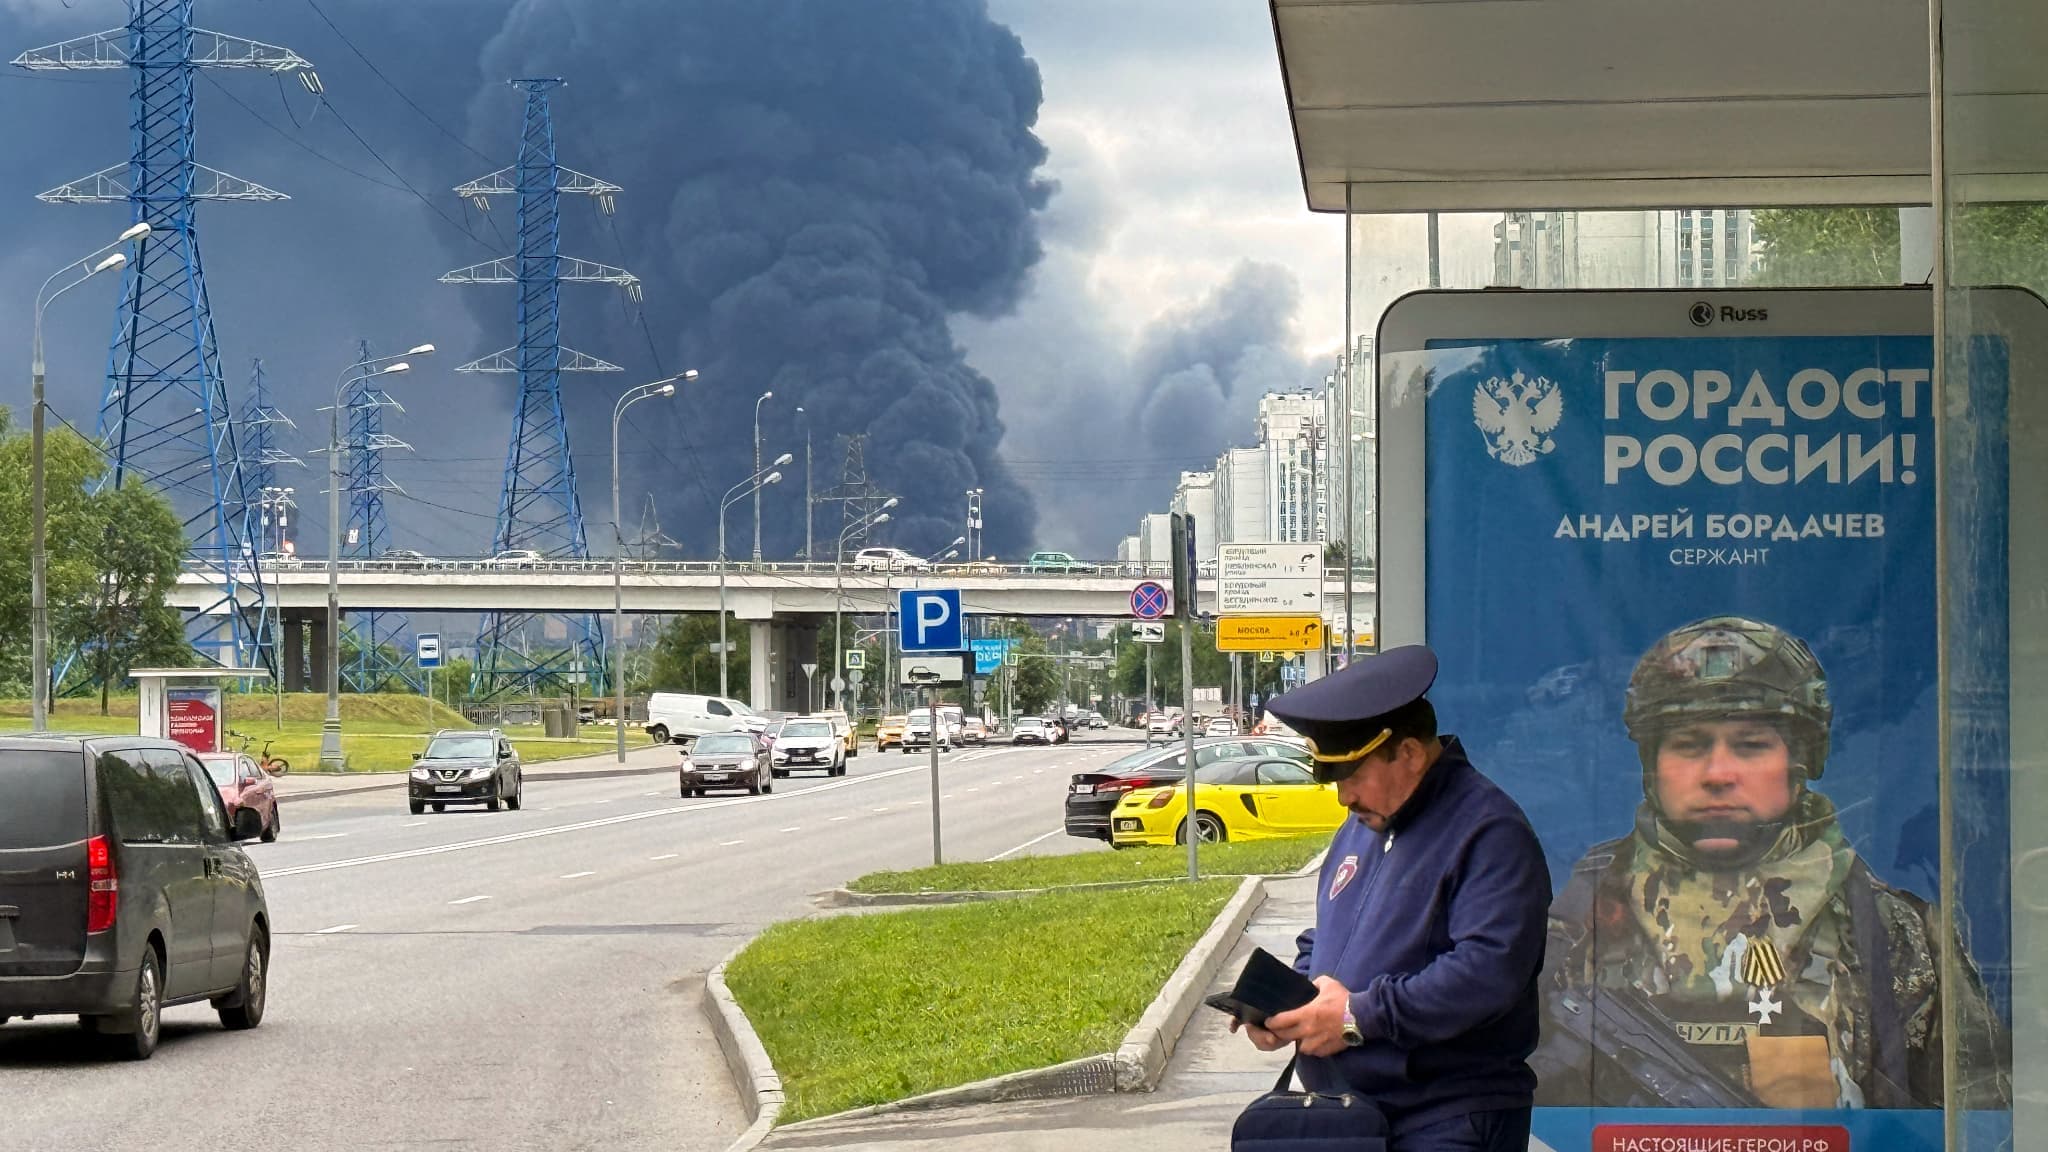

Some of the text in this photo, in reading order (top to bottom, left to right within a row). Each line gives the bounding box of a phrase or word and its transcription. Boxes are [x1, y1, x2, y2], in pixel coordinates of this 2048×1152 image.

[1720, 305, 1768, 322] Russ
[1604, 367, 1942, 426] ГОРДОСТ
[1604, 433, 1916, 486] РОССИИ!
[1553, 508, 1885, 541] АНДРЕЙ БОРДАЧЕВ
[1669, 548, 1770, 566] СЕРЖАНТ
[917, 595, 949, 644] P
